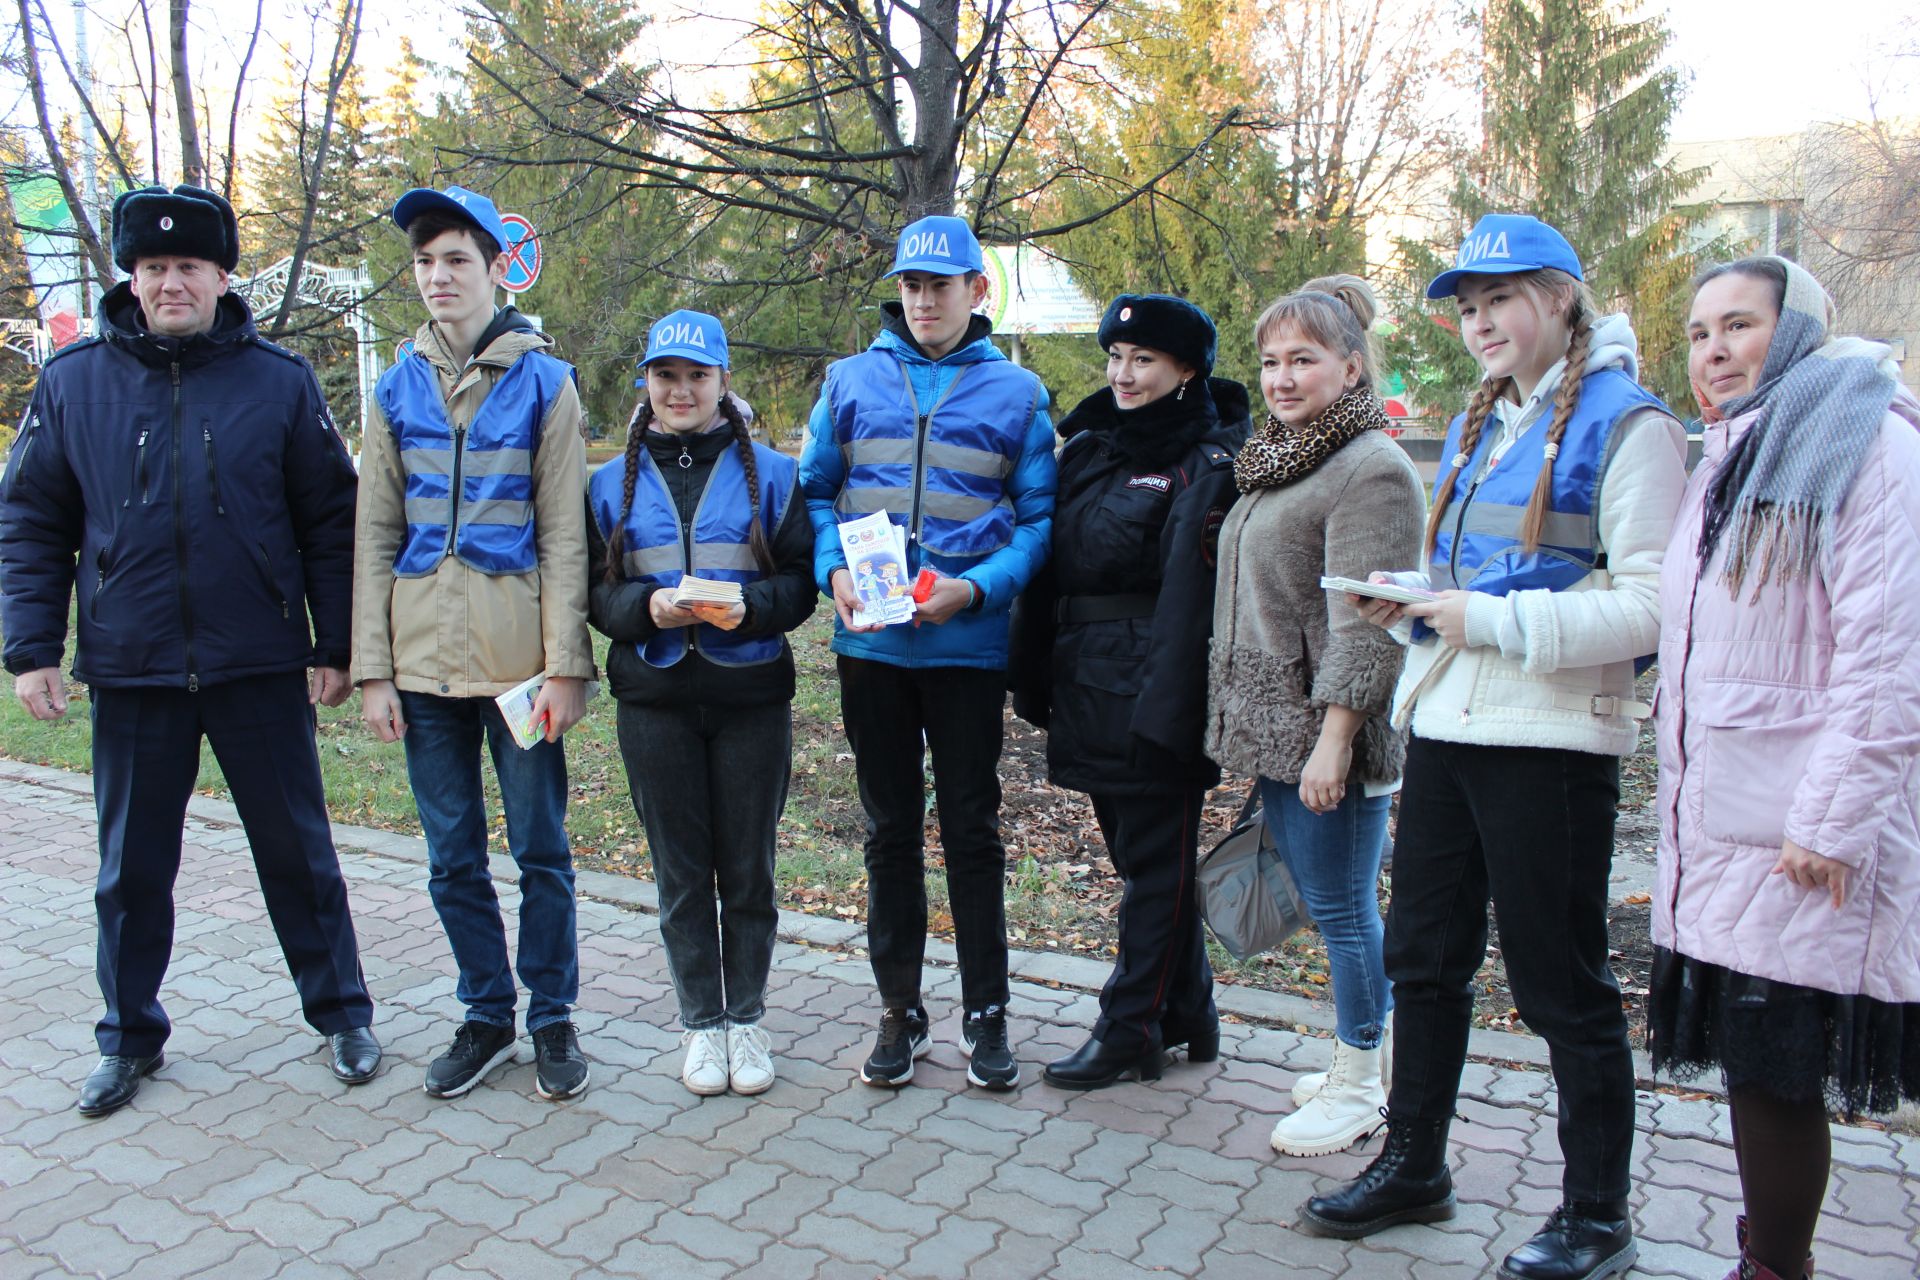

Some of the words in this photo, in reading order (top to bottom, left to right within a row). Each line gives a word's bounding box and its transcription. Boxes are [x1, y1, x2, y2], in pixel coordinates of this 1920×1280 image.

[902, 231, 951, 261] ЮИД
[655, 322, 706, 350] ЮИД
[1130, 476, 1167, 489] ПОЛИЦИЯ
